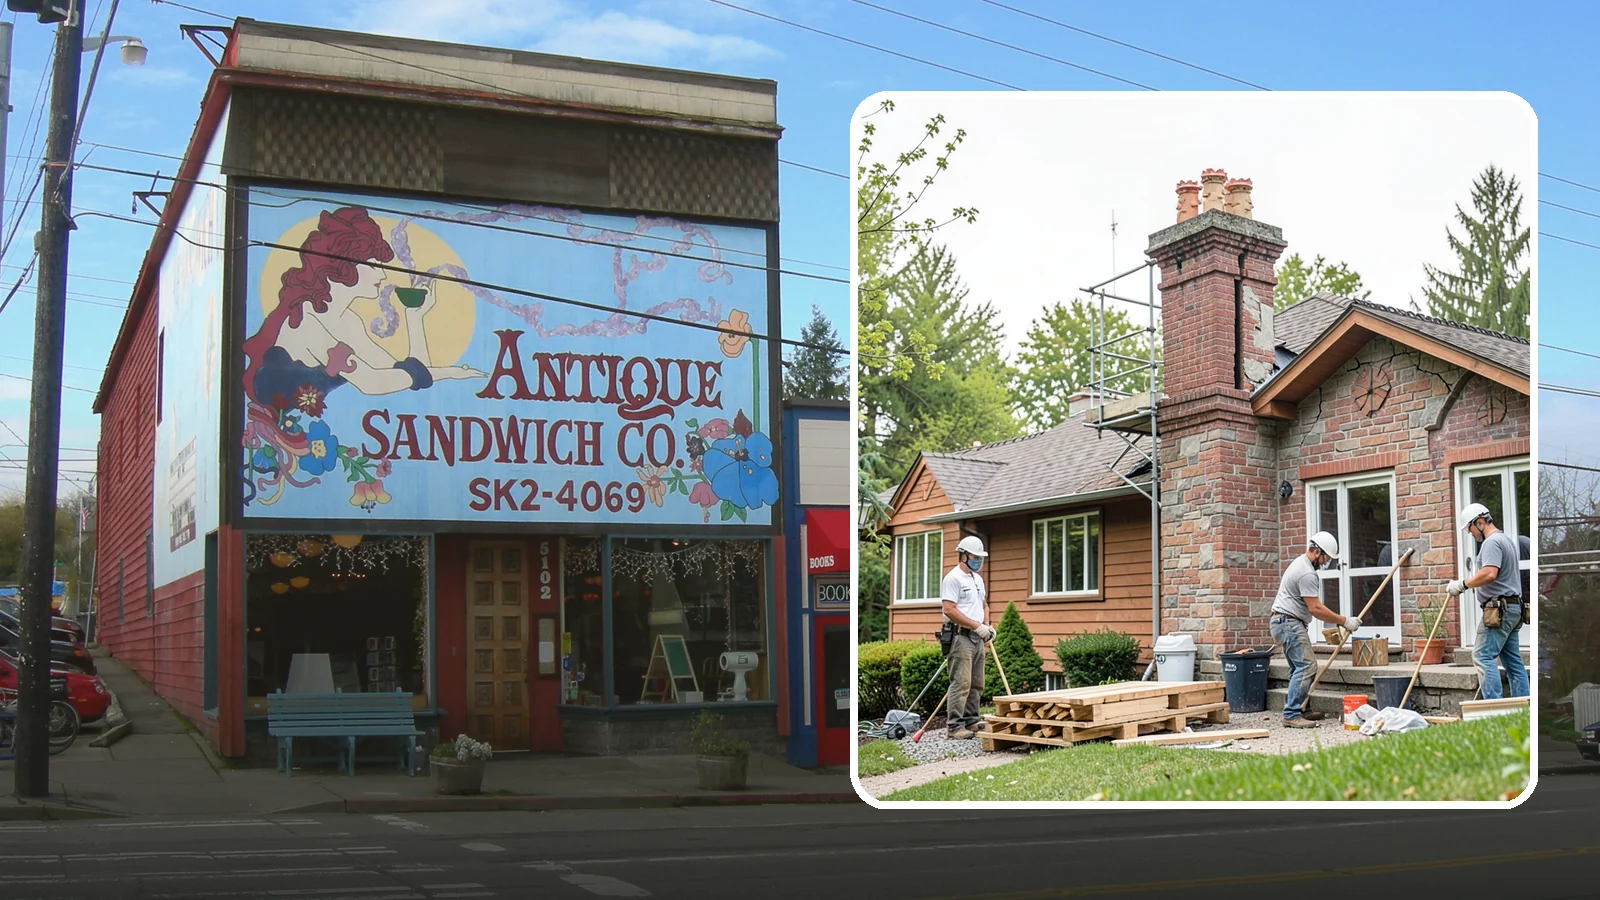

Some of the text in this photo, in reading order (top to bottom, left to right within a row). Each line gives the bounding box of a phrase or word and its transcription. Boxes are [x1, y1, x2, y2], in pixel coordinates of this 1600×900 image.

[476, 329, 723, 420] ANTIQUE
[361, 408, 685, 469] SANDWICH CO.
[468, 477, 645, 513] SK2-4069
[540, 541, 551, 600] 5102
[809, 554, 835, 569] BOOKS
